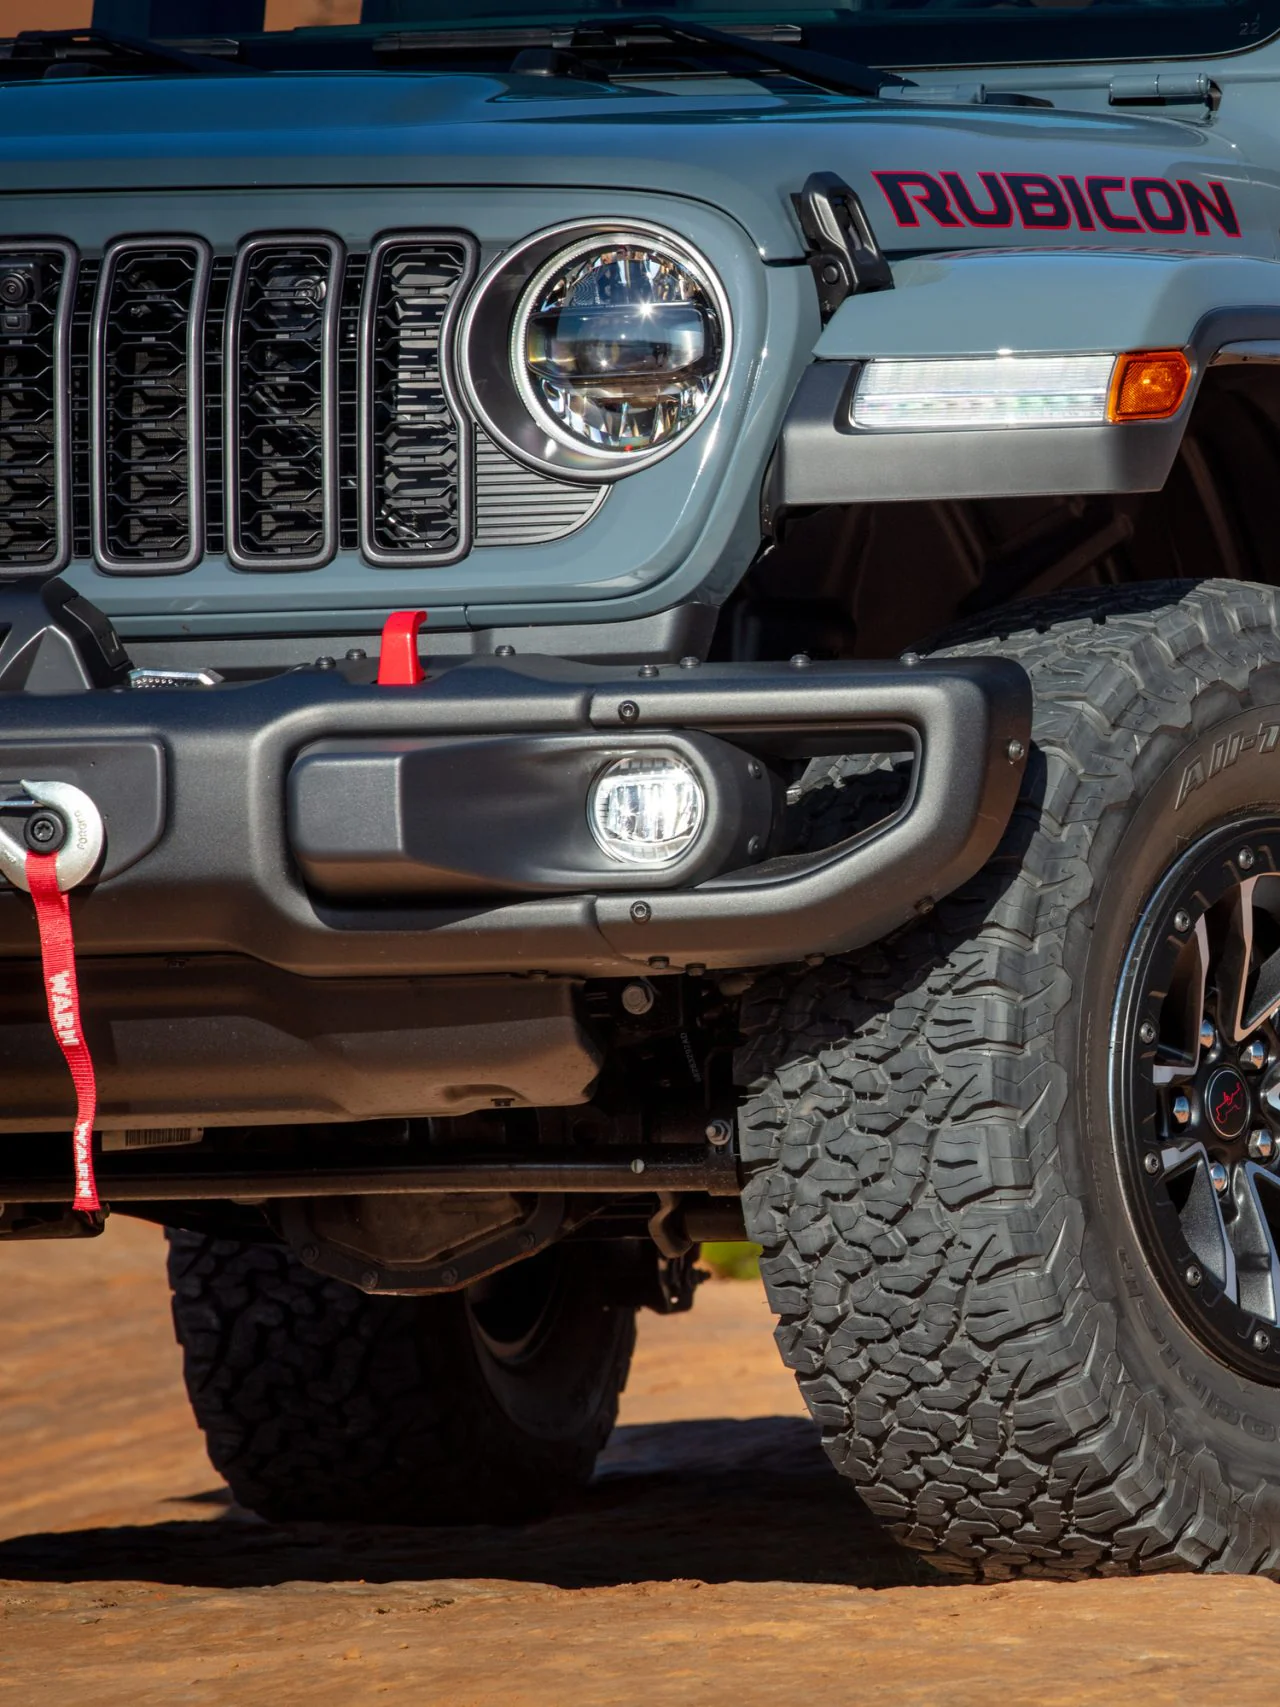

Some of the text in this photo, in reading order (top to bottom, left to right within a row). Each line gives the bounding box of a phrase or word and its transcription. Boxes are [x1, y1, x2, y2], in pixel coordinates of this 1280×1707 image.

[870, 171, 1242, 238] RUBICON
[49, 971, 80, 1047] WARN
[75, 1121, 92, 1198] WARN
